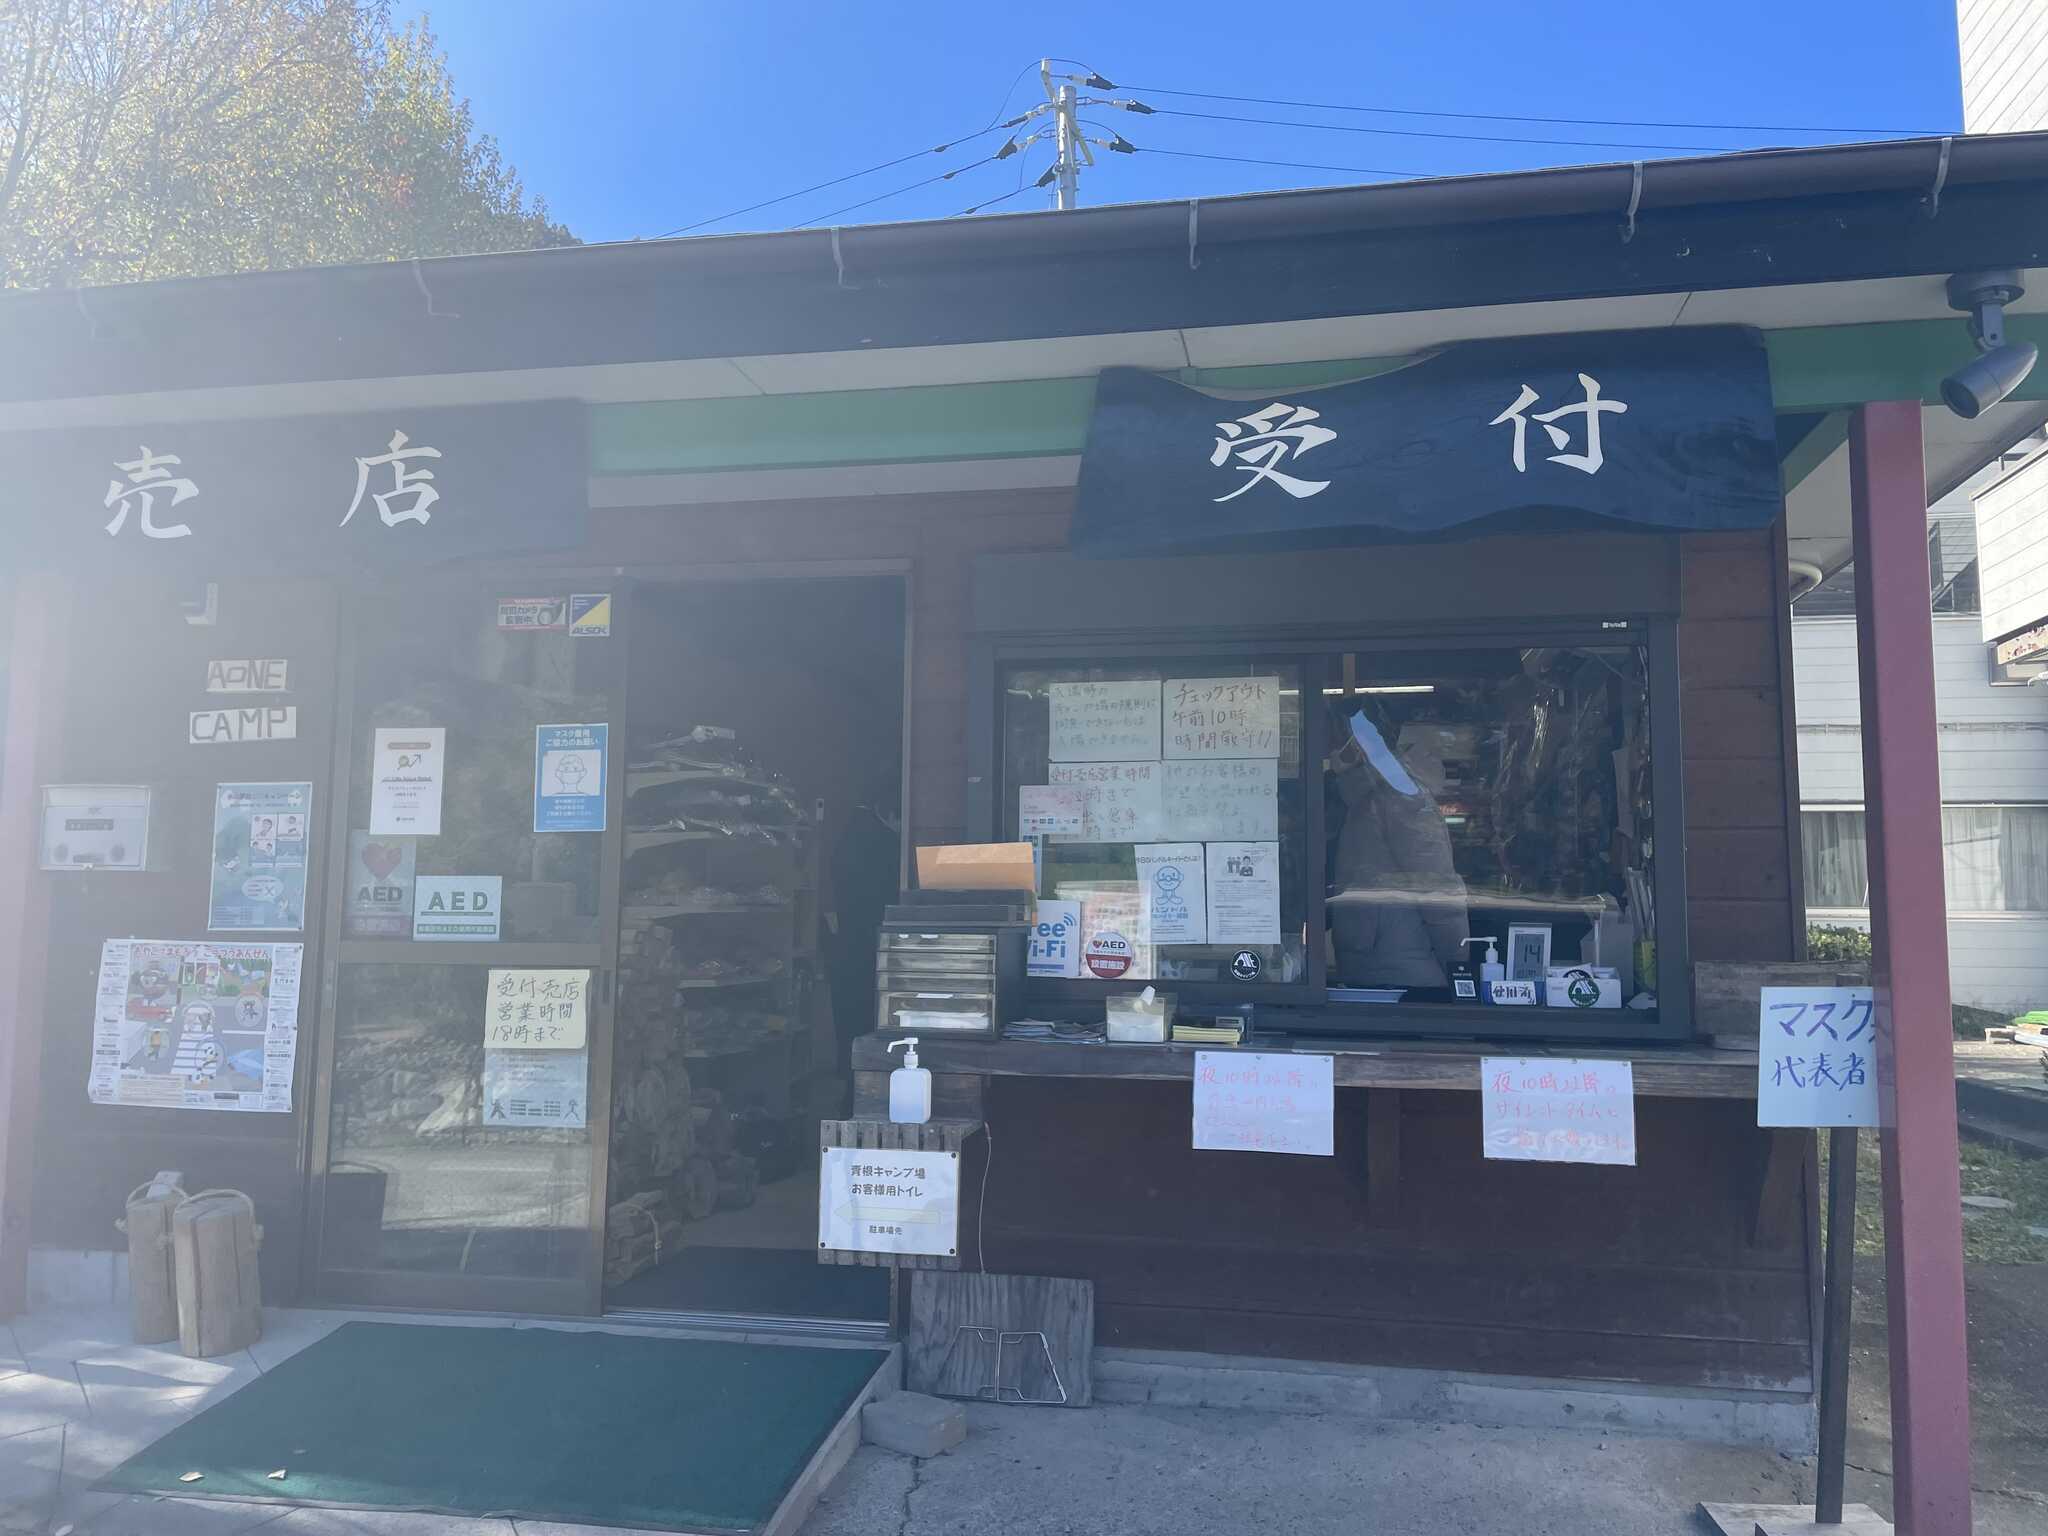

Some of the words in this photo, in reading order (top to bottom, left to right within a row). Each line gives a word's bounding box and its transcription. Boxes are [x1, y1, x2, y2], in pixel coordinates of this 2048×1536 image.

[1210, 373, 1627, 501] 受付
[103, 430, 442, 538] 売店
[571, 626, 607, 635] ALSOK
[1172, 683, 1266, 706] チェックアウト
[191, 708, 288, 741] CAMP
[1172, 709, 1247, 728] 午前10時
[358, 886, 403, 902] AED
[428, 891, 488, 911] AED
[1037, 923, 1066, 937] ee
[1029, 940, 1066, 958] i-Fi
[1102, 941, 1126, 949] AED
[497, 972, 581, 1000] 受付売店
[498, 1002, 573, 1022] 営業時間
[492, 1024, 564, 1044] 18時まで
[1771, 1052, 1866, 1092] 代表者
[851, 1164, 926, 1179] 青根キャンプ場
[852, 1183, 923, 1198] お客様用トイレ
